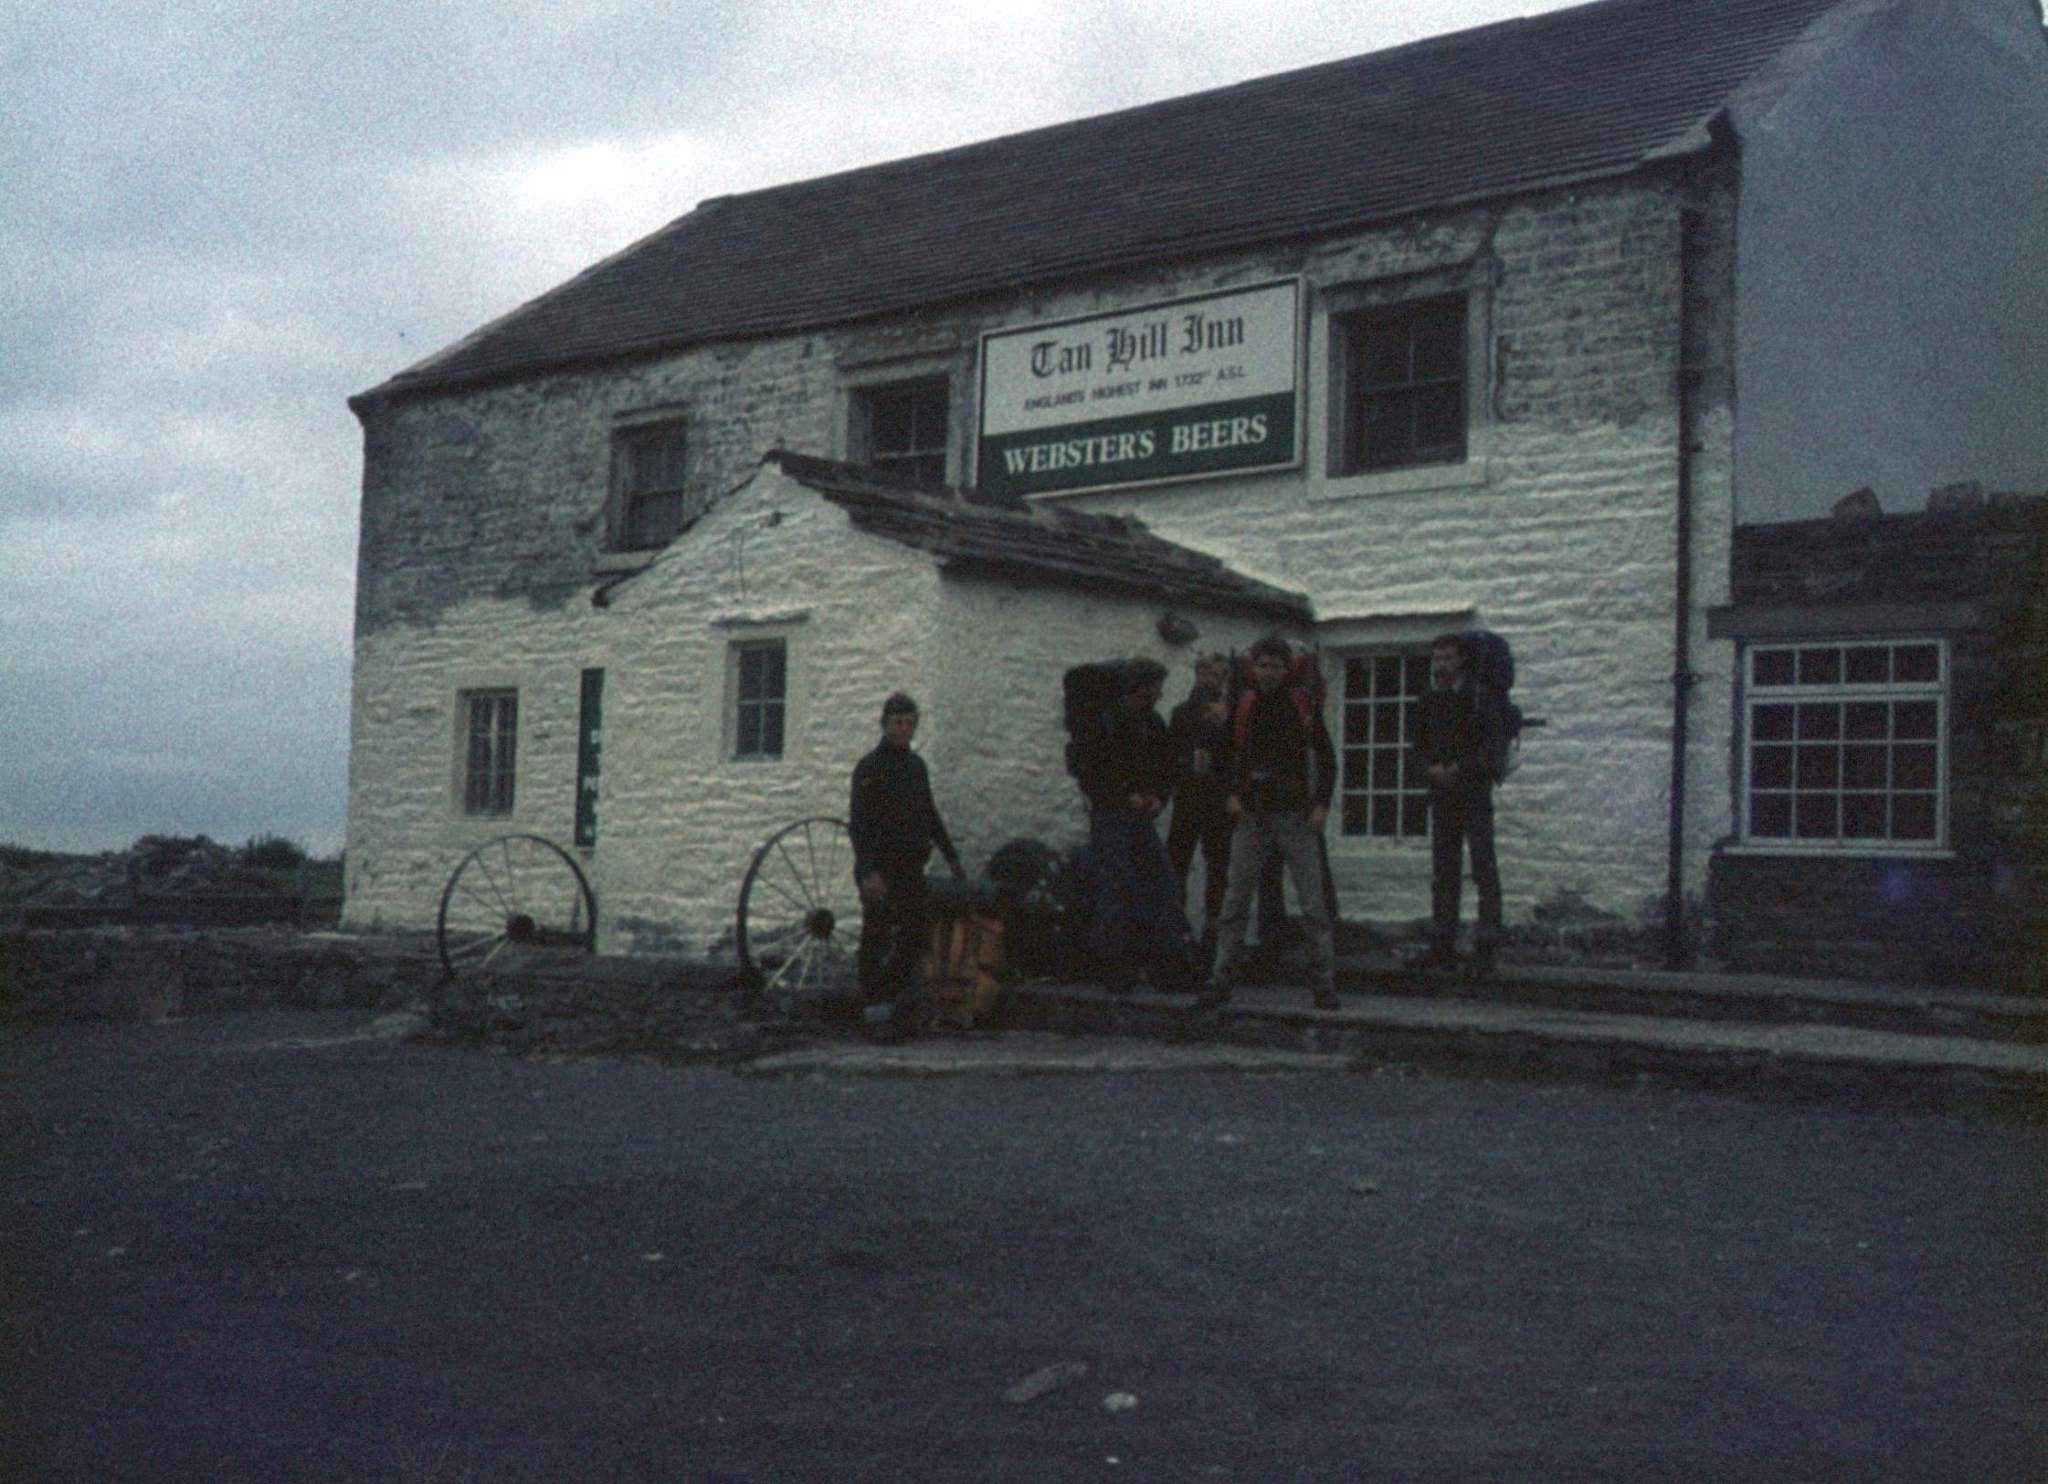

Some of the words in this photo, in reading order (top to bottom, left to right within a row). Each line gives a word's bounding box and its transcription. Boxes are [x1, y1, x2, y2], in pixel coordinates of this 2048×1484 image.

[1031, 340, 1091, 378] Tan
[1106, 320, 1168, 373] Hill
[1180, 313, 1244, 354] Inn
[1093, 381, 1141, 400] HIGHEST
[1148, 378, 1168, 391] INN
[1171, 413, 1267, 454] BEERS
